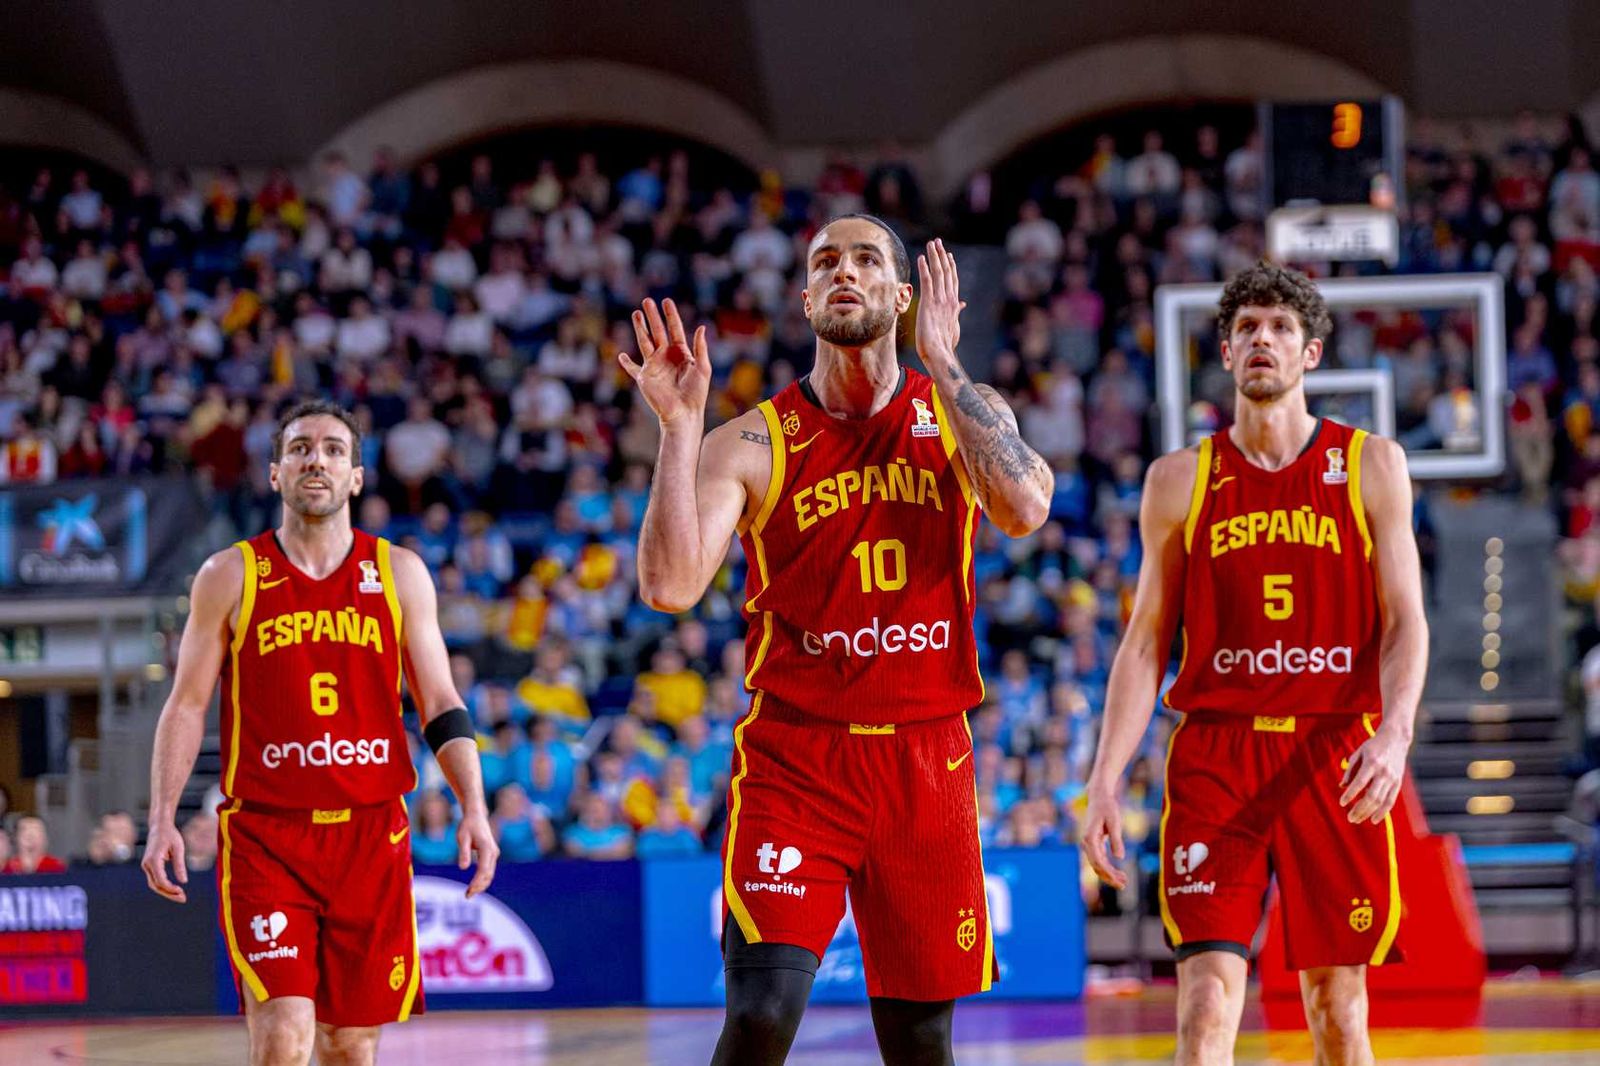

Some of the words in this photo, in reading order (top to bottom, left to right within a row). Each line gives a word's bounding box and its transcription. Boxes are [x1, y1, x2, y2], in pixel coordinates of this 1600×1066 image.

[1331, 102, 1363, 149] 3
[793, 457, 943, 532] ESPAÑA
[1210, 505, 1342, 558] ESPAÑA
[851, 538, 908, 593] 10
[1263, 574, 1294, 620] 5
[257, 606, 384, 656] ESPAÑA
[802, 616, 950, 657] endesa
[1213, 639, 1352, 675] endesa
[309, 672, 339, 716] 6
[262, 732, 390, 769] endesa
